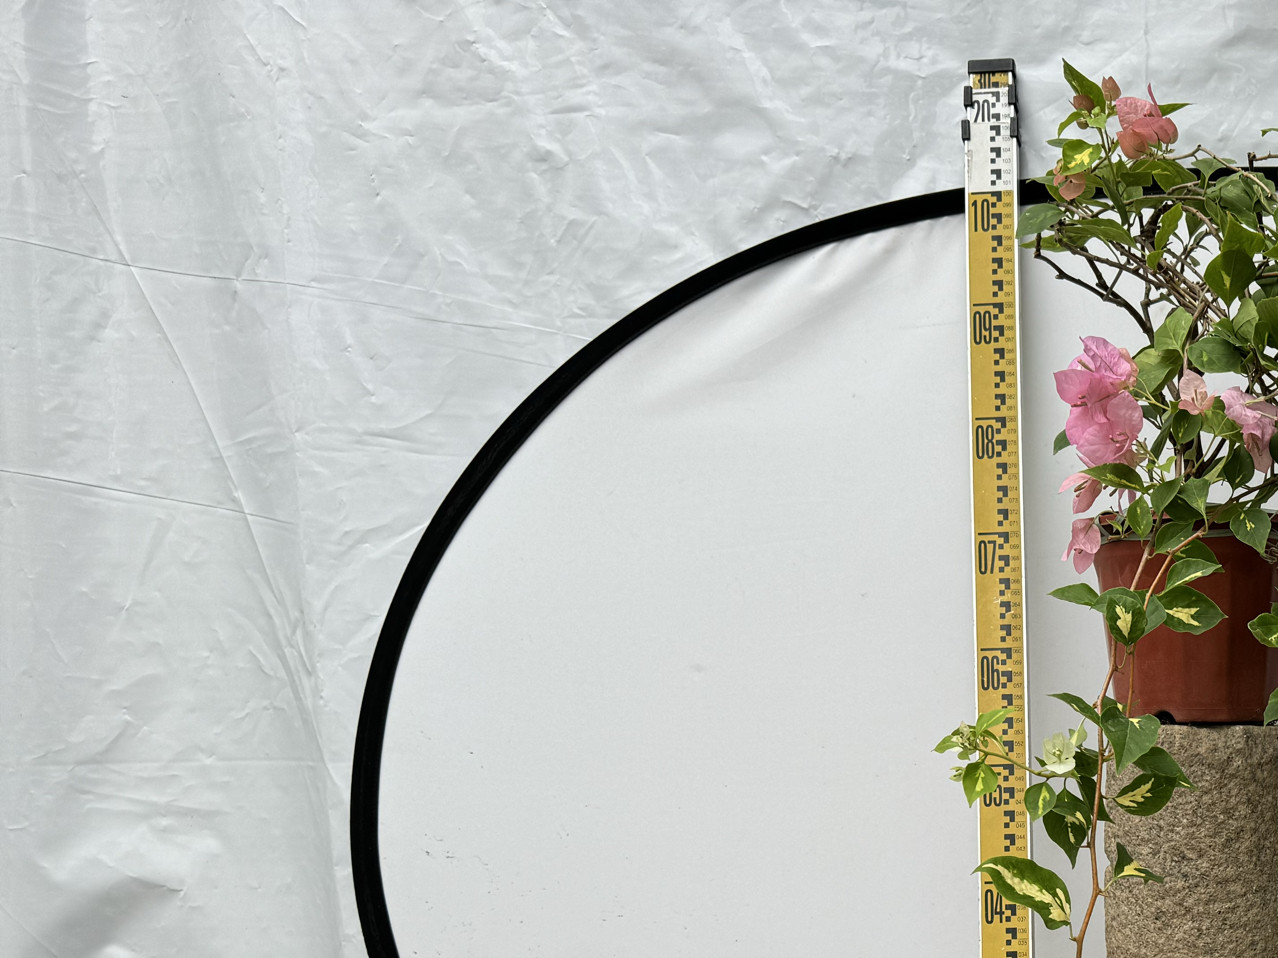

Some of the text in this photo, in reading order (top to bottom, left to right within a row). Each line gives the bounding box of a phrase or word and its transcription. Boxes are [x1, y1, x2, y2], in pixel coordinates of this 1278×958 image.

[972, 199, 991, 232] 10
[973, 311, 993, 346] 09
[976, 424, 995, 460] 08
[978, 540, 997, 575] 07
[981, 655, 1000, 691] 06
[984, 889, 1005, 925] 04
